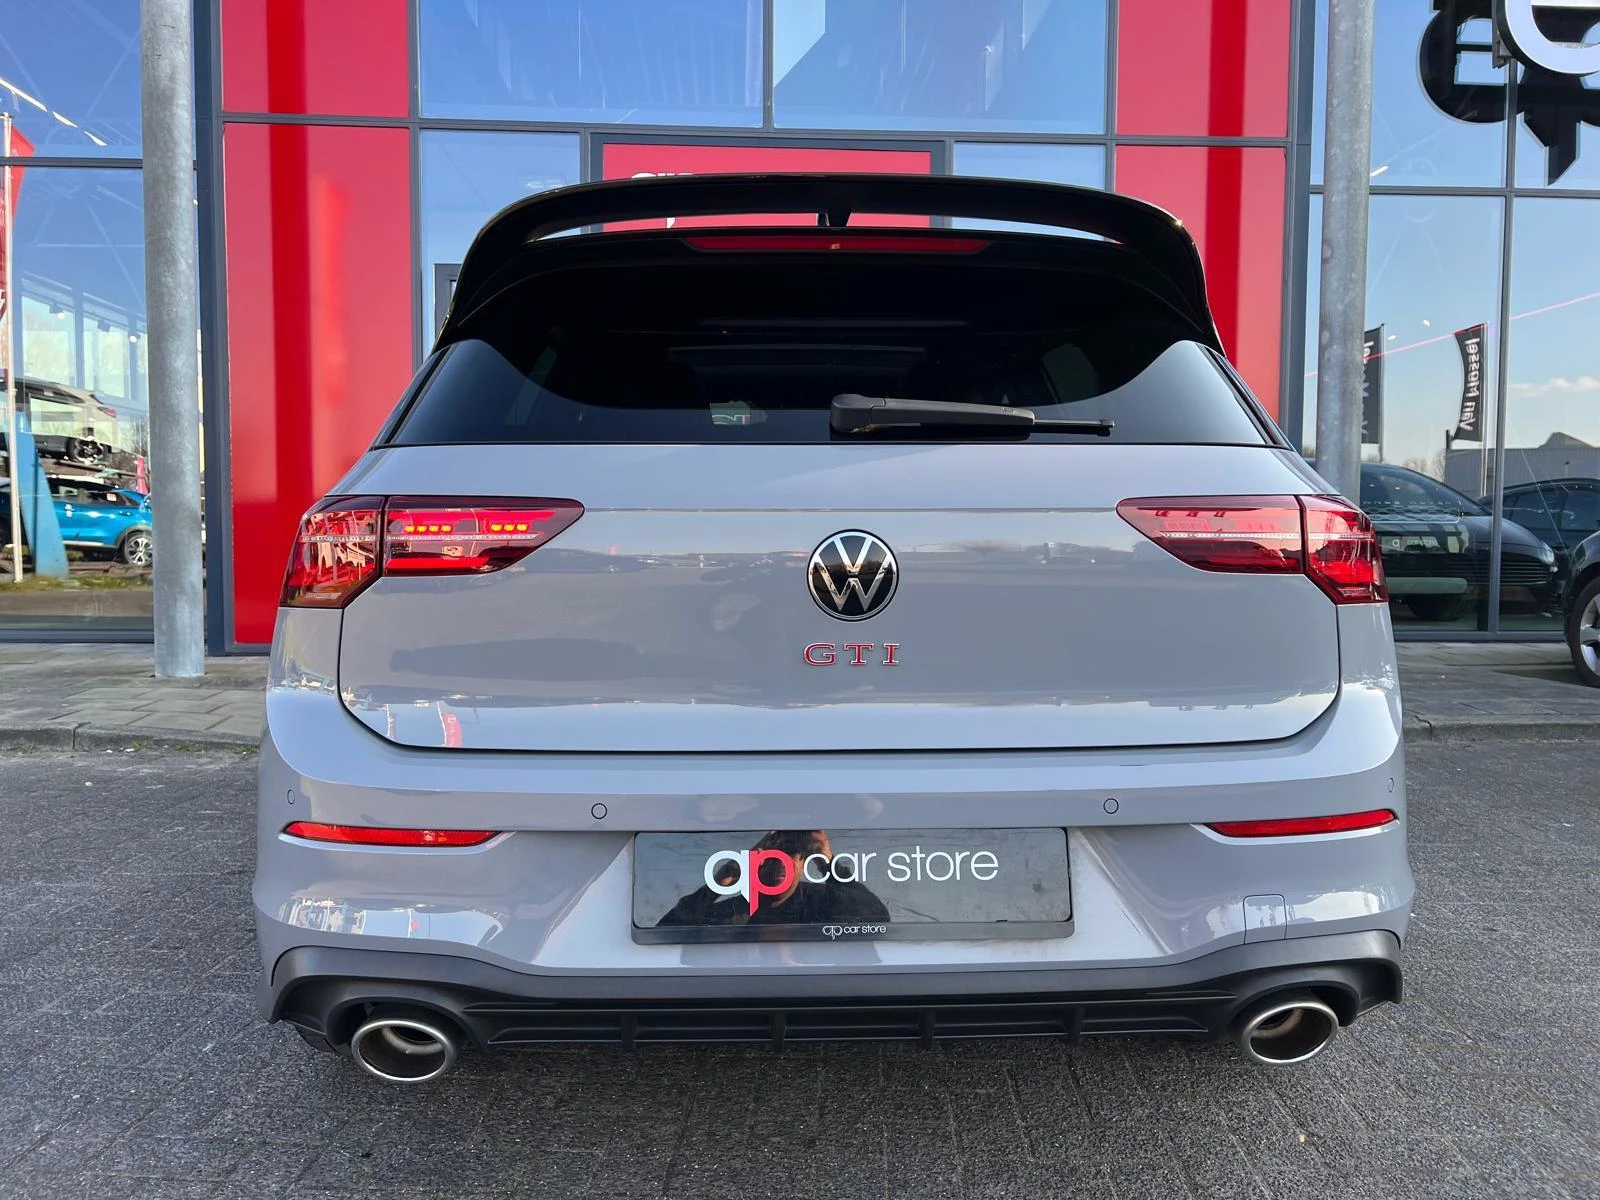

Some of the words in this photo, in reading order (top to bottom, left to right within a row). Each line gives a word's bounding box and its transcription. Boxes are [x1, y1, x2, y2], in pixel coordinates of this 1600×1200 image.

[803, 641, 900, 667] GTI
[803, 852, 877, 883] car
[887, 845, 999, 882] store
[843, 926, 861, 934] car
[861, 924, 887, 934] store
